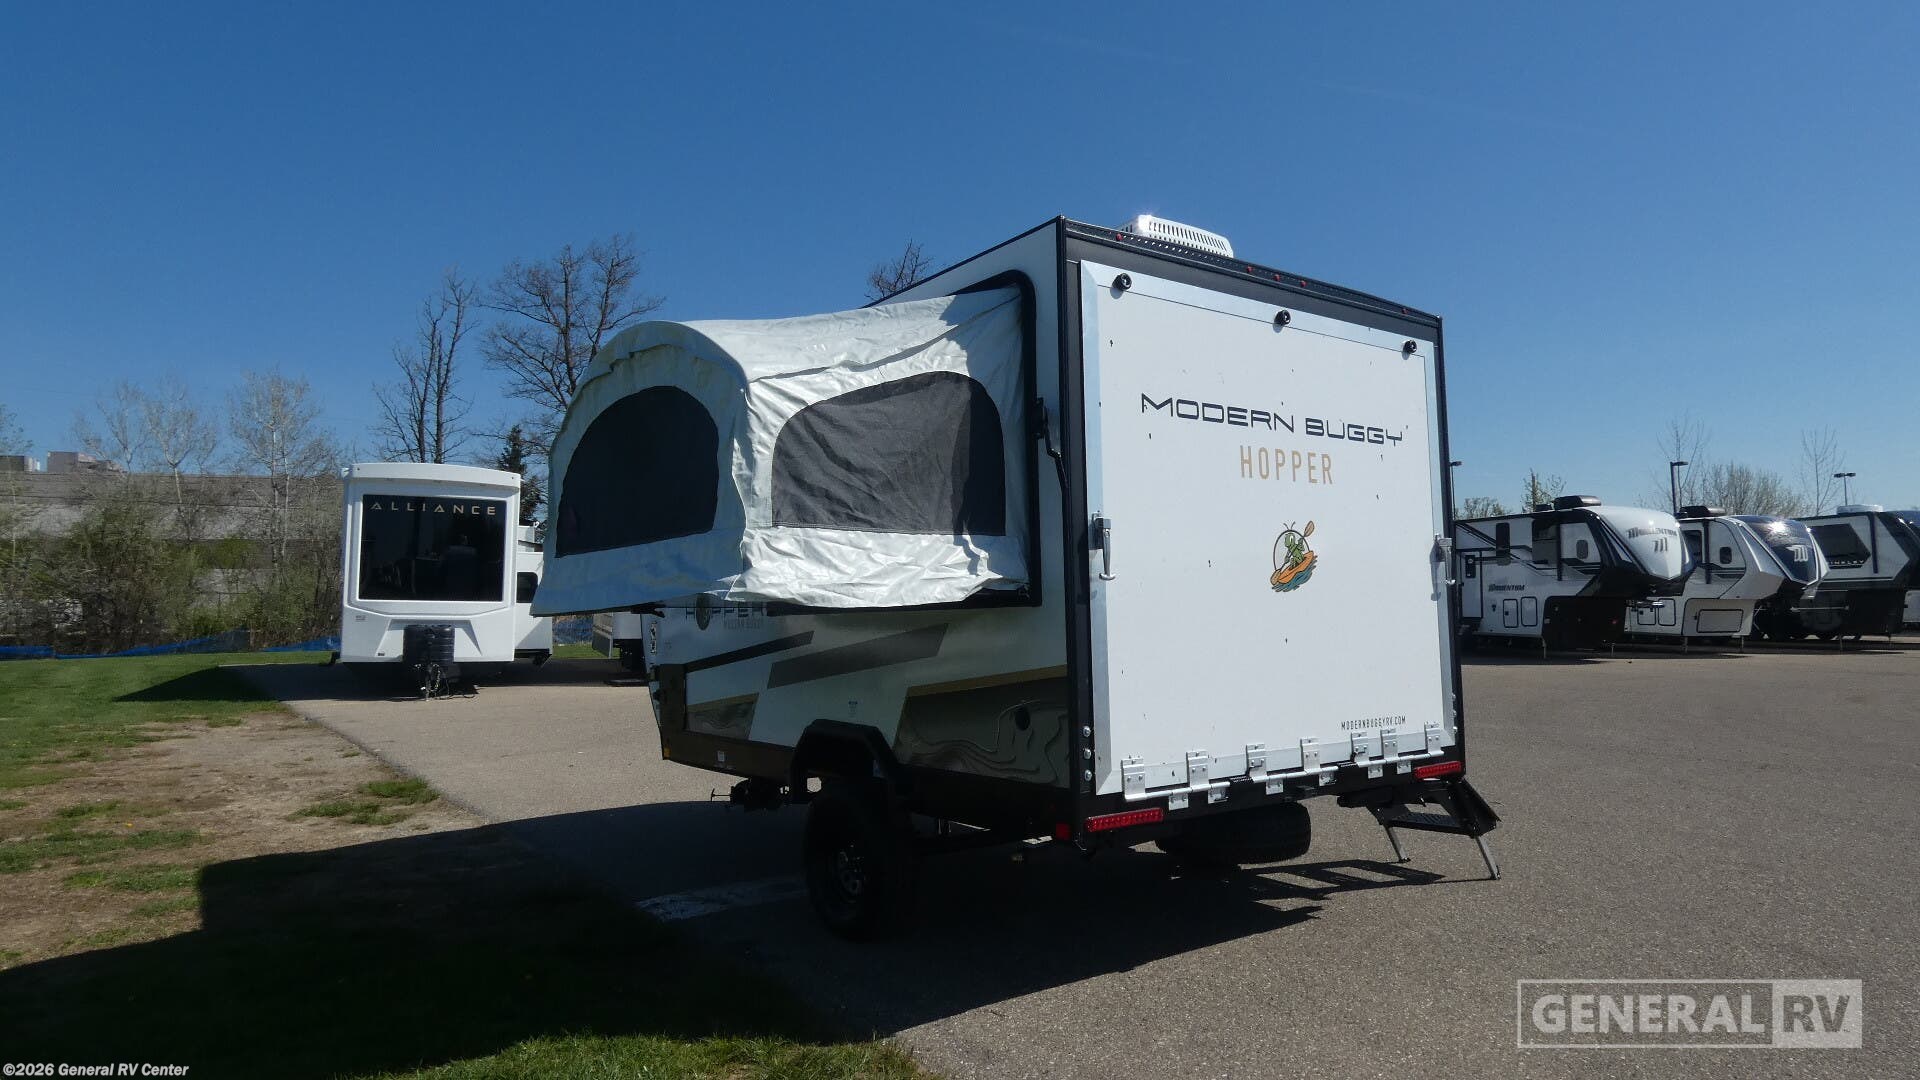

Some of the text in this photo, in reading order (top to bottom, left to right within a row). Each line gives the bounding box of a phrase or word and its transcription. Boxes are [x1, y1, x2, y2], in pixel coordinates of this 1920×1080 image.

[1141, 392, 1403, 447] MODERN BUGGY
[1239, 445, 1333, 485] HOPPER
[370, 502, 496, 516] ALLIANCE
